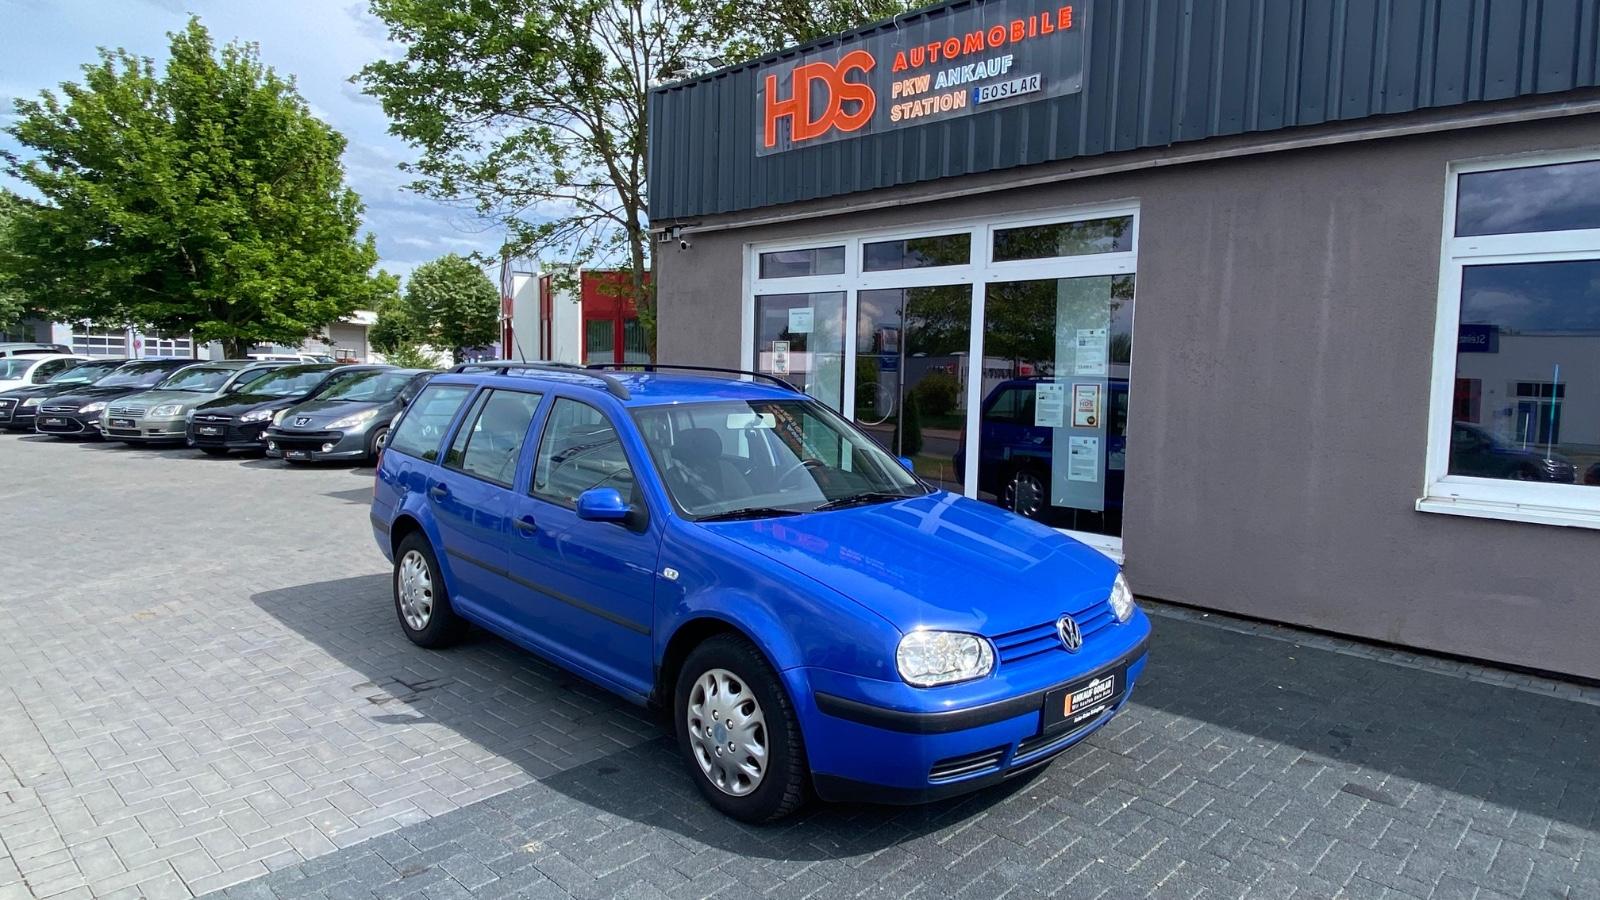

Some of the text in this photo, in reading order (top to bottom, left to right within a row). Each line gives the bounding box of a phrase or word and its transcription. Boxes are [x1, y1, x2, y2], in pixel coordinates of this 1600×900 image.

[892, 5, 1073, 72] AUTOMOBILE
[764, 50, 876, 147] HDS
[892, 54, 1013, 99] PKW ANKAUF
[982, 76, 1037, 100] GOSLAR
[890, 90, 967, 122] STATION
